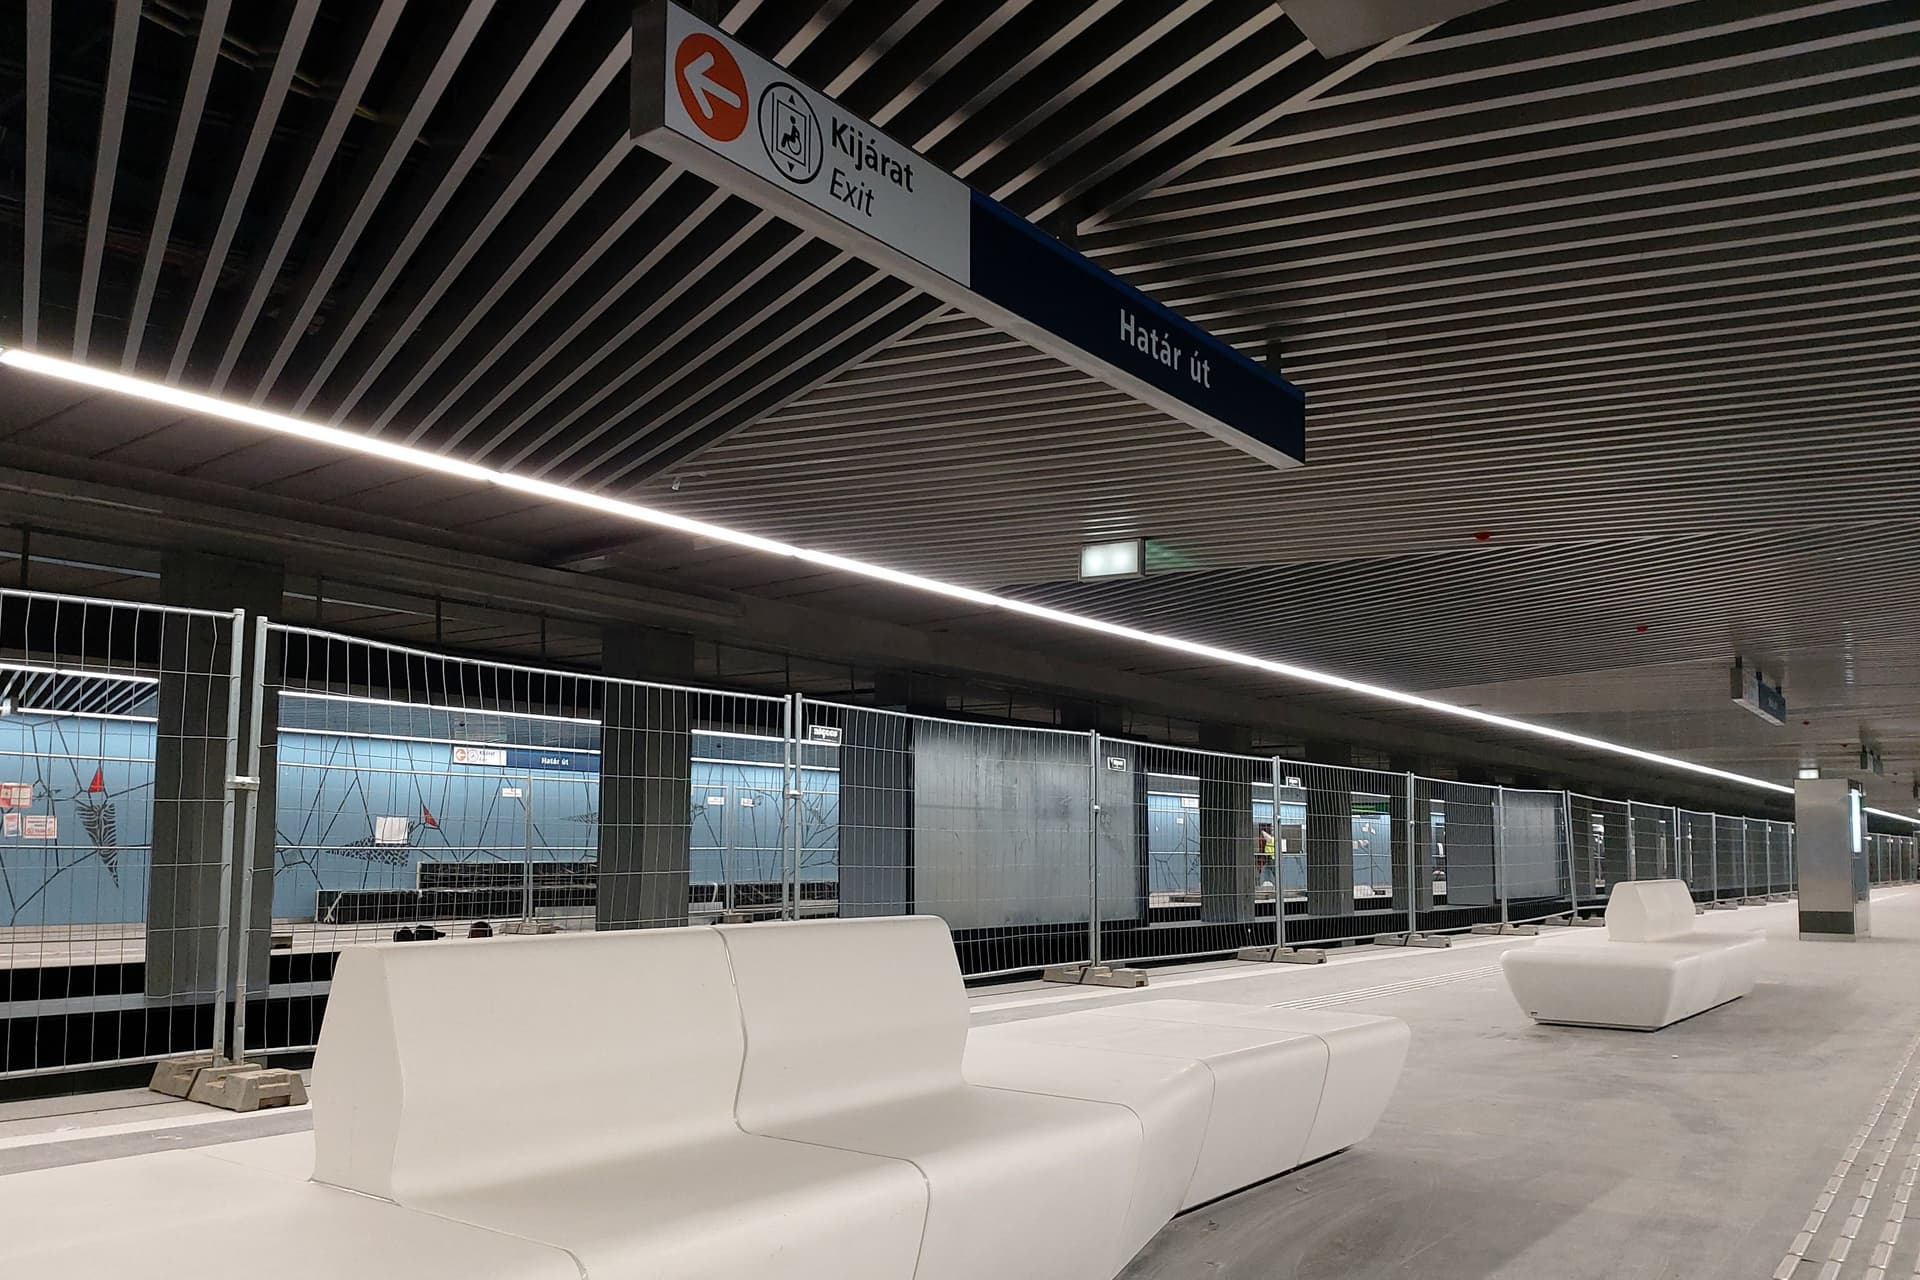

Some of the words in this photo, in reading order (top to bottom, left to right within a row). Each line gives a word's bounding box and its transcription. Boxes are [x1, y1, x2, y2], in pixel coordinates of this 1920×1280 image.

[830, 167, 874, 217] Exit
[832, 116, 914, 193] Kijárat
[1120, 308, 1182, 371] Határ
[1190, 350, 1211, 389] út
